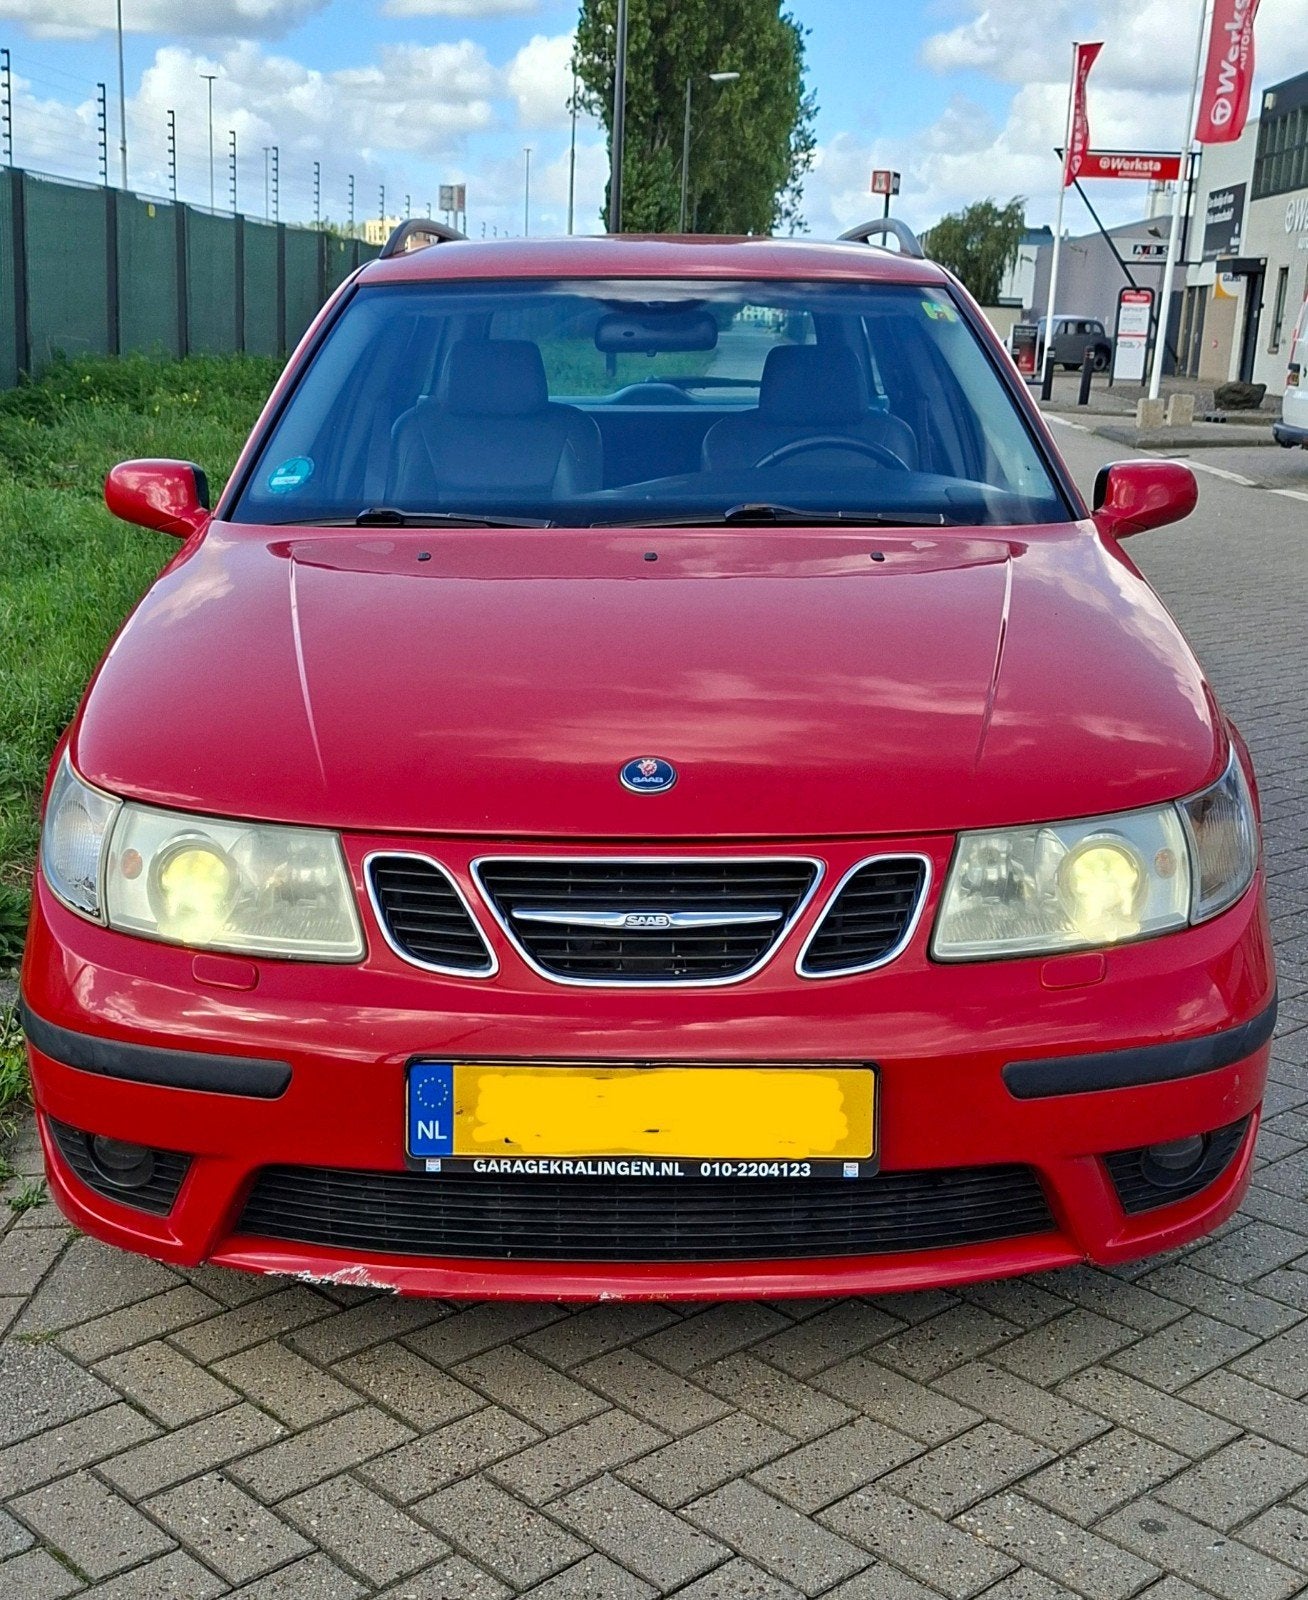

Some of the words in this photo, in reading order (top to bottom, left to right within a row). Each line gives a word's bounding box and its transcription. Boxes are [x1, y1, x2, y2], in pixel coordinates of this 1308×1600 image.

[1111, 157, 1161, 171] Werksta
[626, 916, 668, 926] SAAB
[417, 1120, 447, 1140] NL
[473, 1159, 684, 1177] GARAGEKRALINGEN.NL
[700, 1162, 811, 1177] 010-2204123
